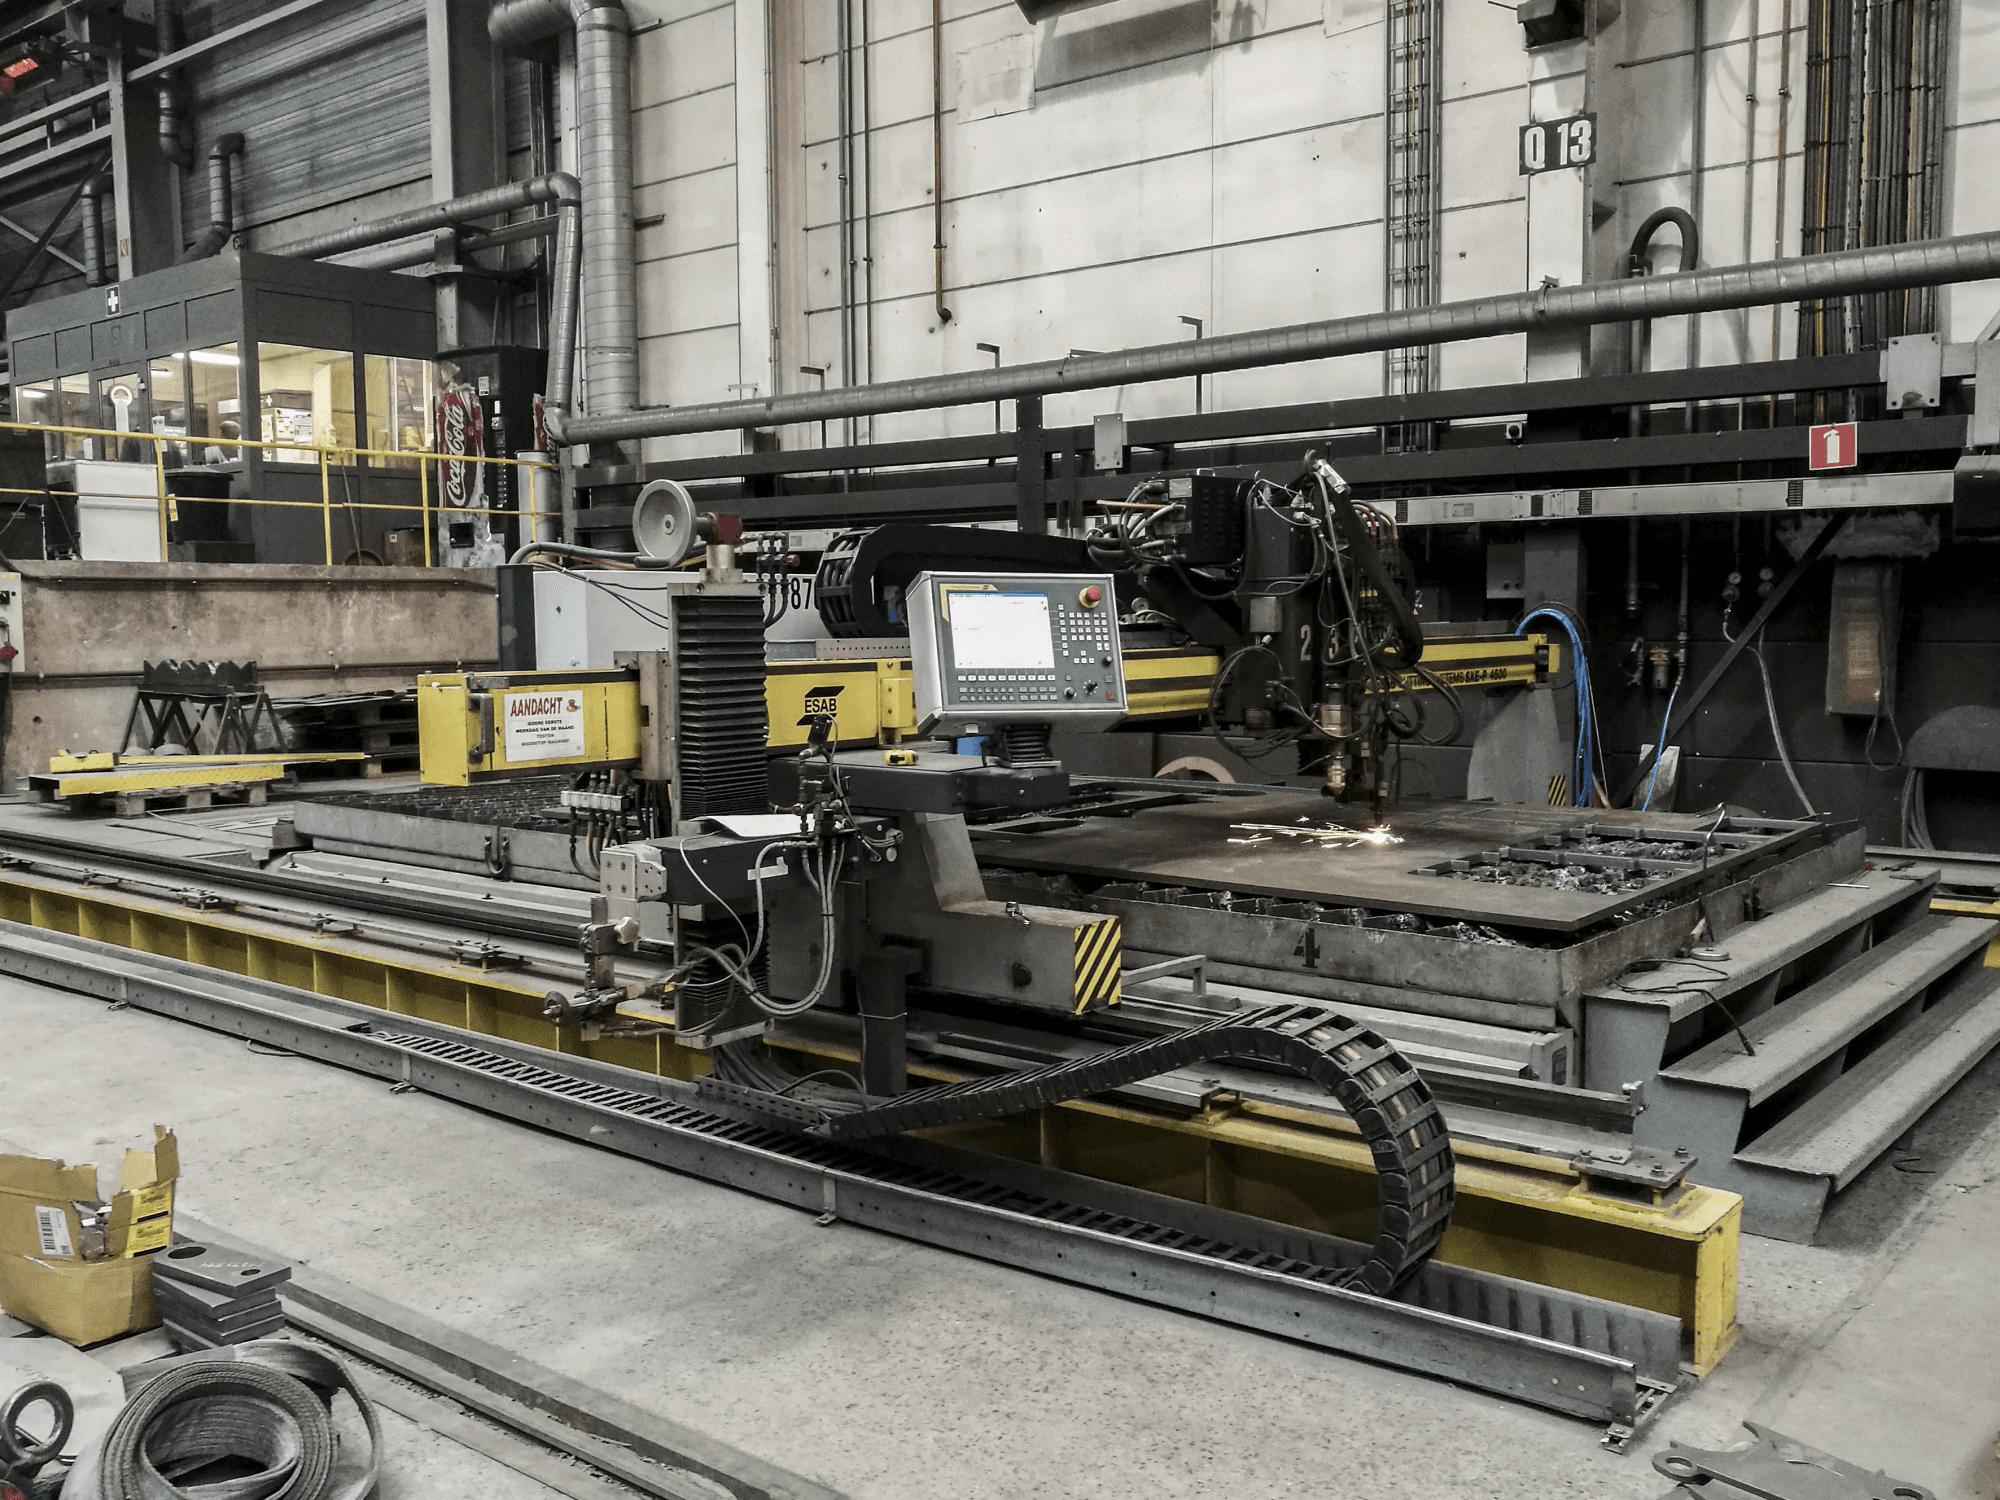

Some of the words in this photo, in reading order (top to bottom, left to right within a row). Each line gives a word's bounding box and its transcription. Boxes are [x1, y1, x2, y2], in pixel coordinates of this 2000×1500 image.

[1525, 126, 1546, 169] Q
[1557, 120, 1592, 165] 13
[444, 403, 466, 506] CocaCola
[1300, 624, 1312, 661] 2
[1328, 625, 1339, 660] 3
[511, 697, 563, 717] AANDACHT
[804, 698, 838, 714] ESAB
